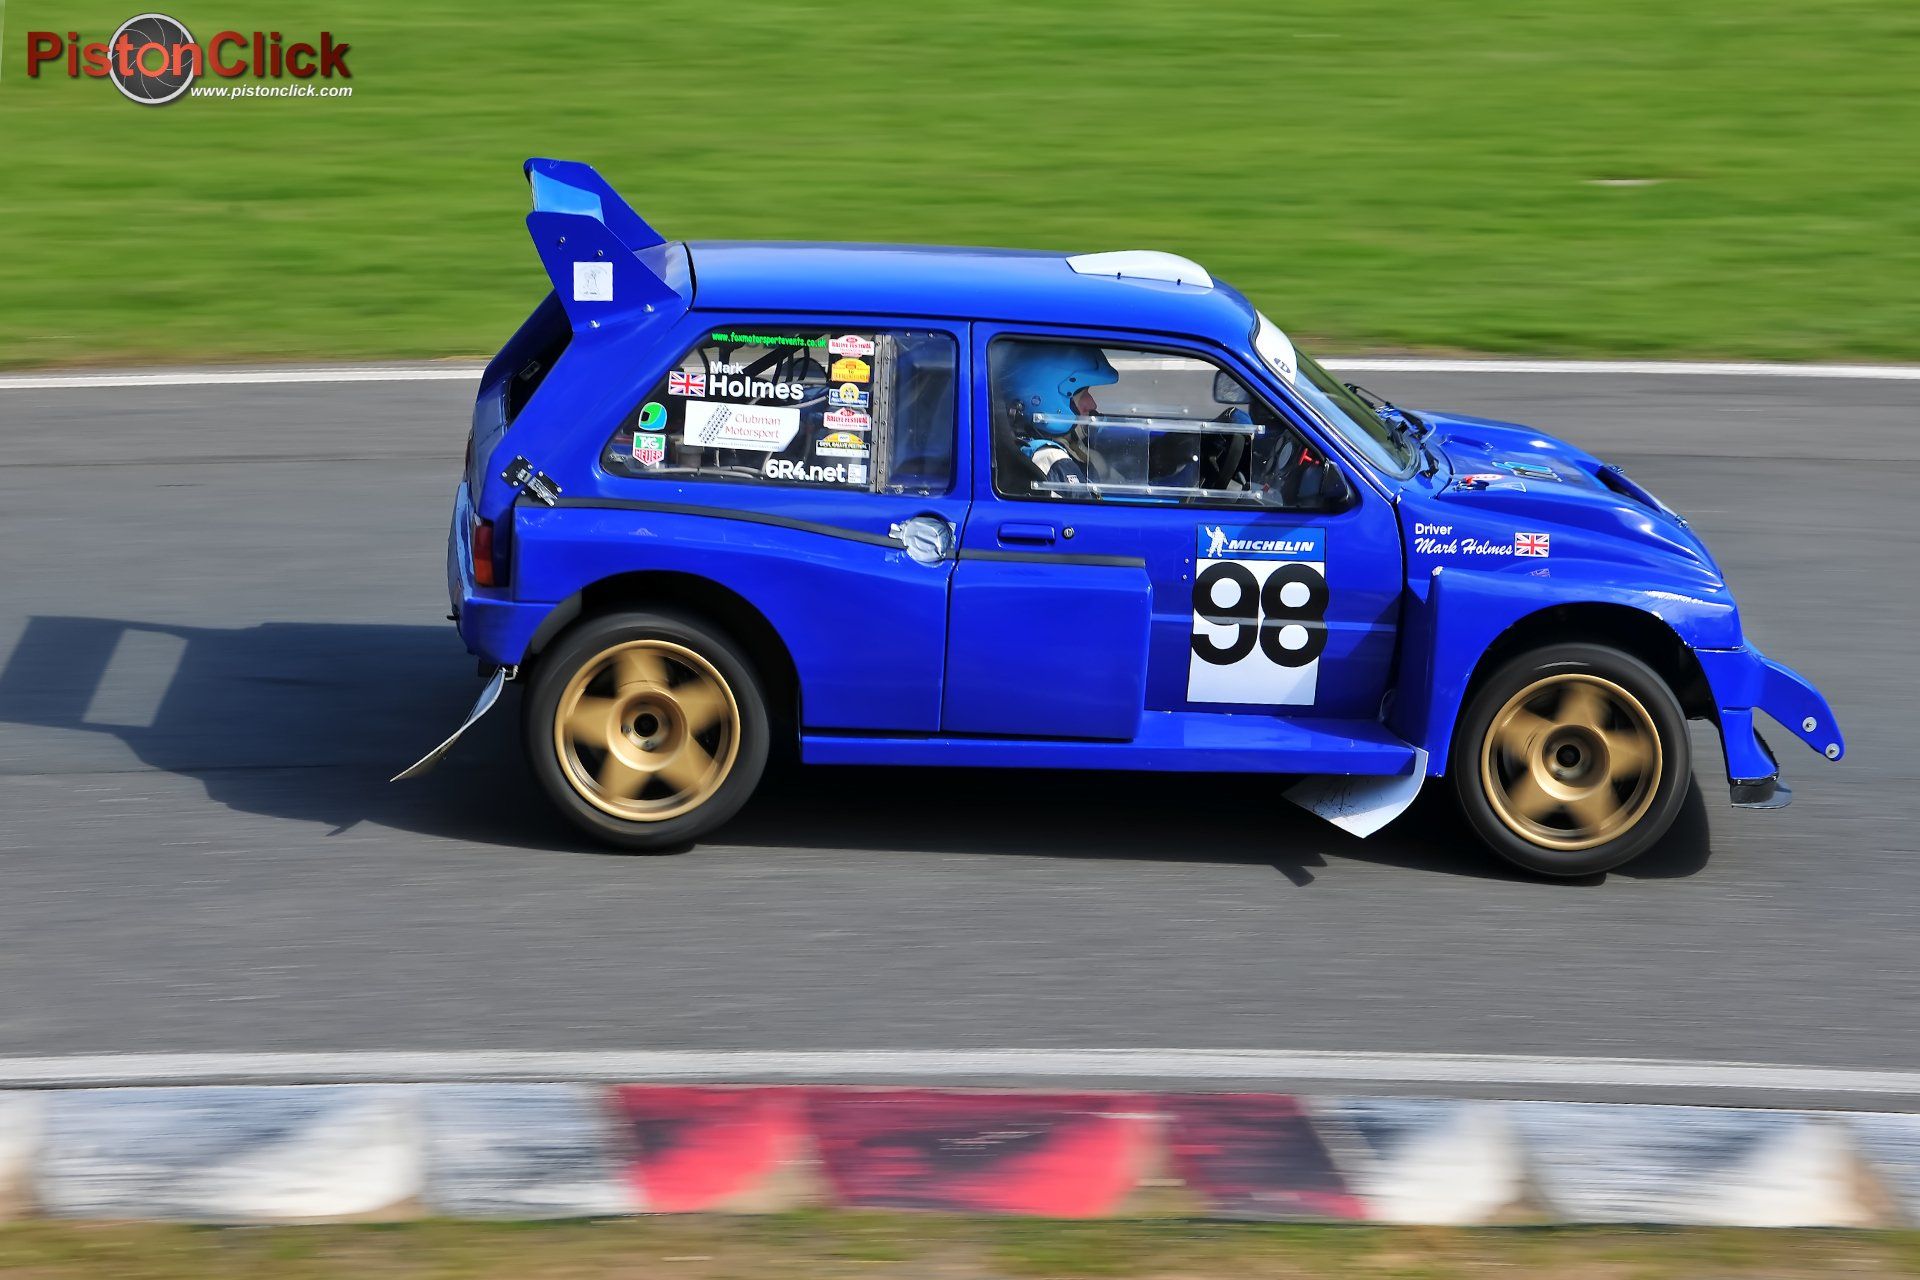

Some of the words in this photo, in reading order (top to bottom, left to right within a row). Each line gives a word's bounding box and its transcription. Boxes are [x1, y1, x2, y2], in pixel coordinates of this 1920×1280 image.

[712, 331, 827, 347] www.foxmotorsportevents.co.uk
[710, 361, 744, 375] Mark
[709, 375, 804, 400] Holmes
[735, 413, 781, 425] Clubman
[725, 425, 779, 439] Motorsport
[765, 459, 846, 483] 6R4.net
[1415, 522, 1453, 535] Driver
[1228, 540, 1315, 552] MICHELIN
[1414, 538, 1458, 554] Mark
[1461, 539, 1513, 556] Holmes
[1190, 562, 1329, 667] 98
